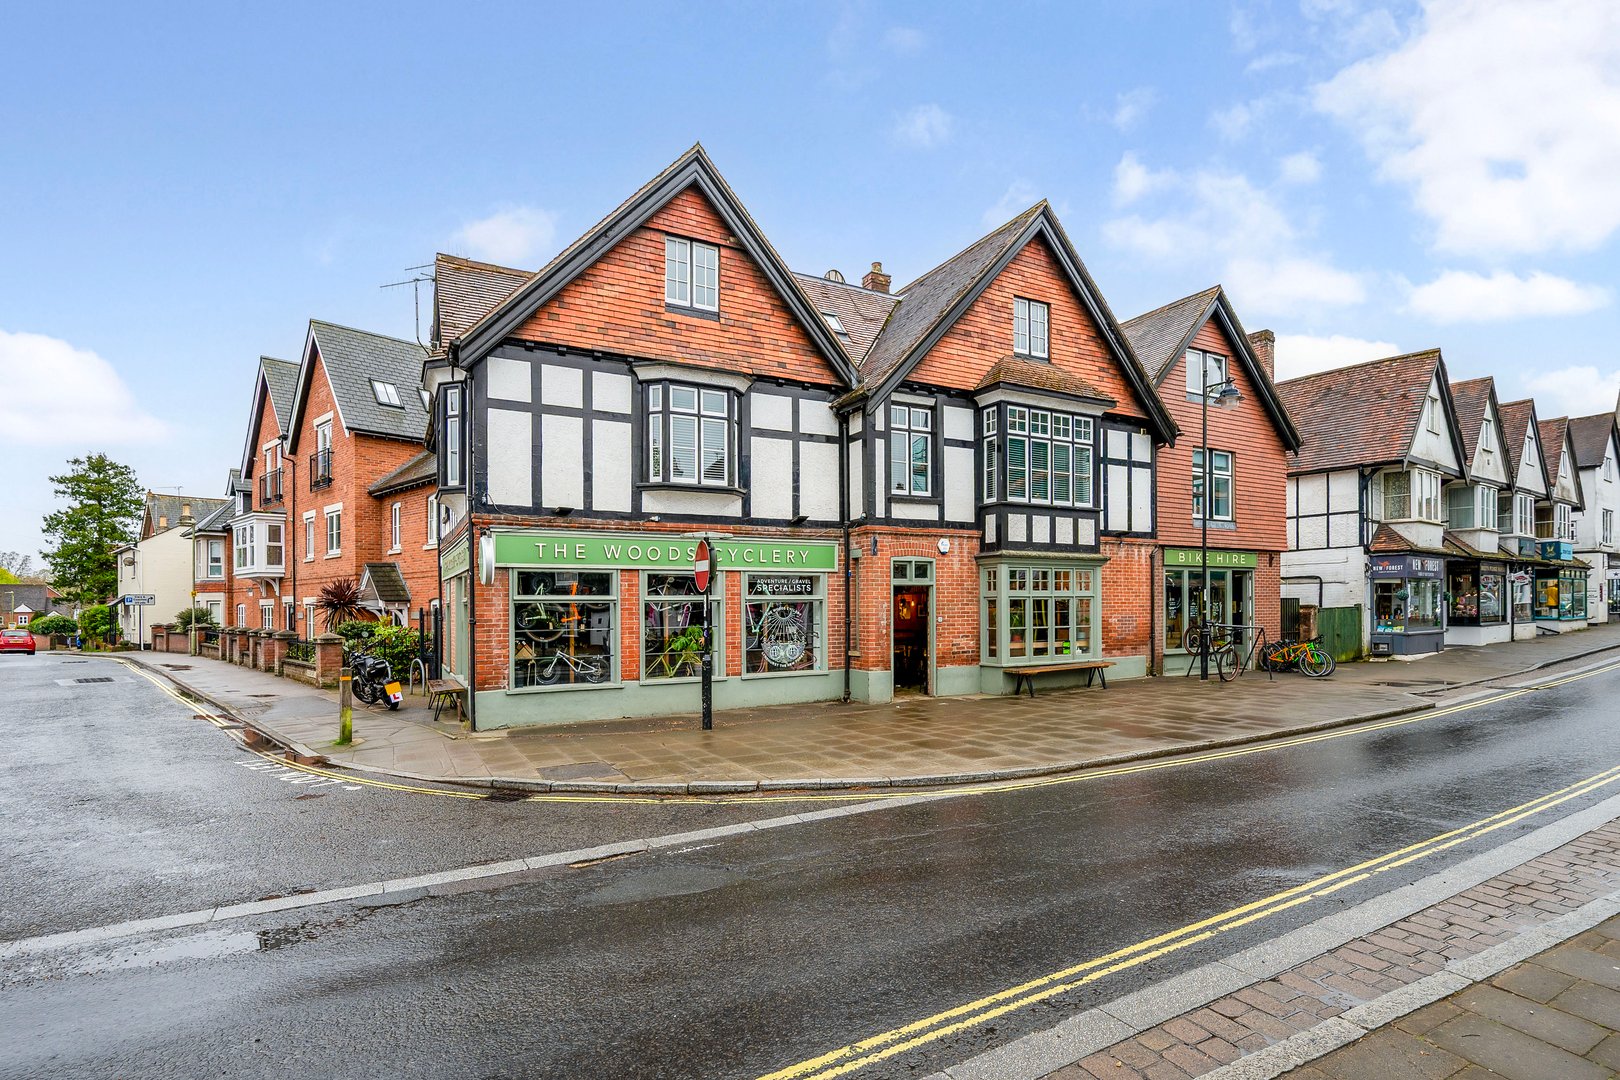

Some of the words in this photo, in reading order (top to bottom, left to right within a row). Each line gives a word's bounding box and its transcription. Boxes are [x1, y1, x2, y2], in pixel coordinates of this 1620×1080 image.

[535, 542, 587, 559] THE
[603, 544, 695, 562] WOODS
[715, 547, 810, 564] CYCLERY
[1178, 552, 1210, 563] BIKE
[1216, 554, 1246, 564] HIRE
[757, 584, 812, 592] SPECIALISTS
